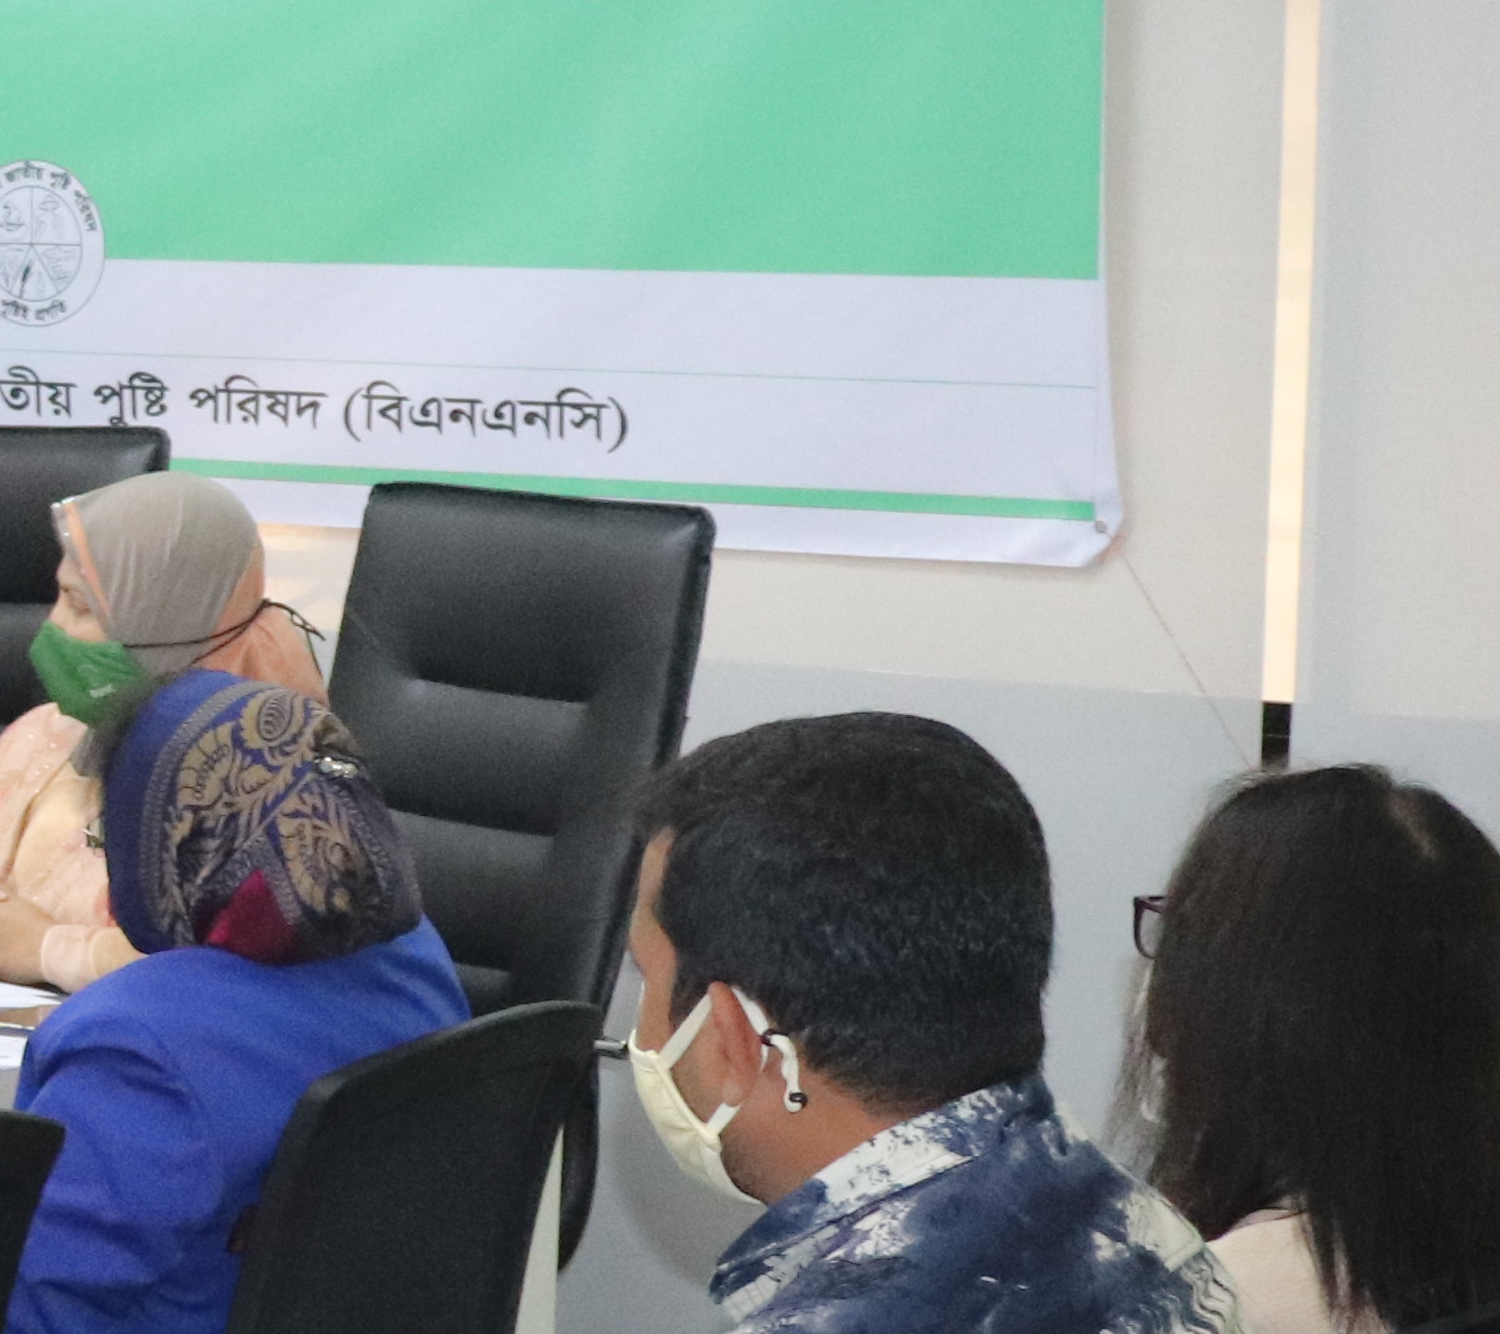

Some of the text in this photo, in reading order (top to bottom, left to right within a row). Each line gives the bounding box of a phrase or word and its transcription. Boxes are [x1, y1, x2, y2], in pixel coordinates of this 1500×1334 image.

[94, 370, 170, 429] পুষ্টি
[189, 381, 327, 429] পরিষদ
[343, 387, 629, 455] (বিএনএনসি)
